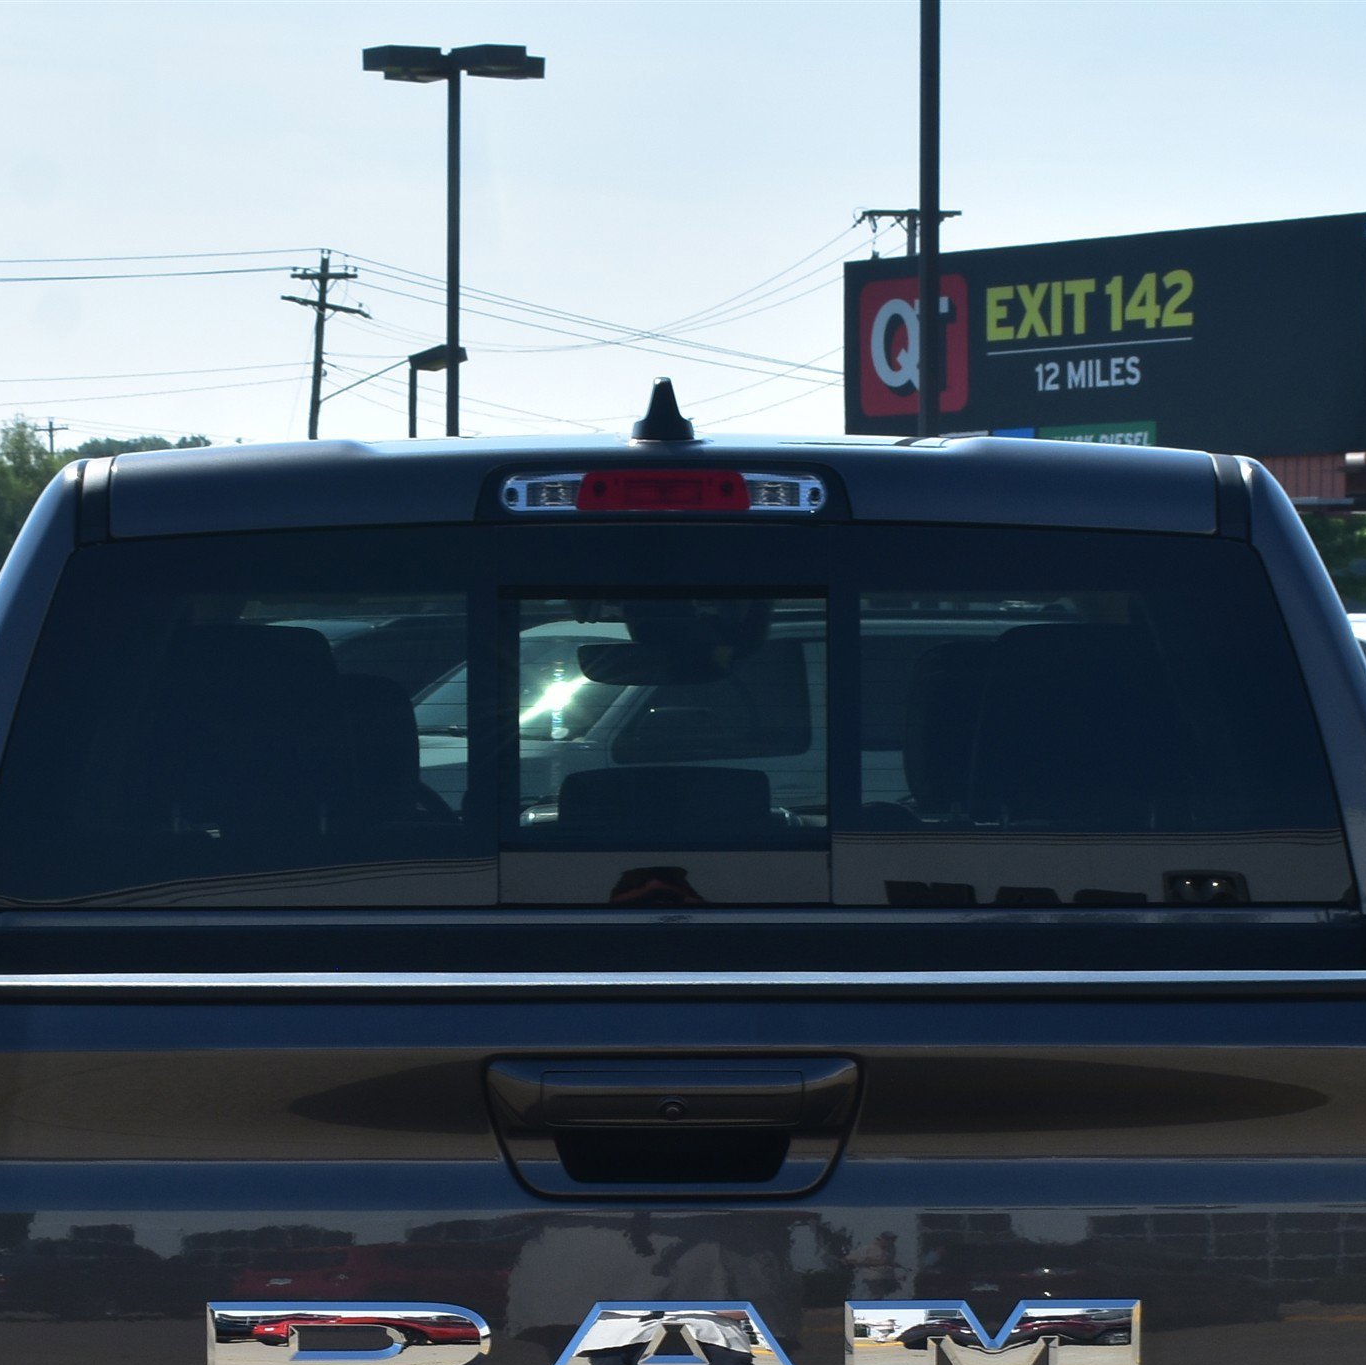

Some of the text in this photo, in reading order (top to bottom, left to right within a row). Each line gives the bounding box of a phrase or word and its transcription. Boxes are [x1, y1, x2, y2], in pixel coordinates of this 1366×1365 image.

[986, 269, 1194, 342] EXIT 142
[1035, 356, 1141, 391] 12 MILES
